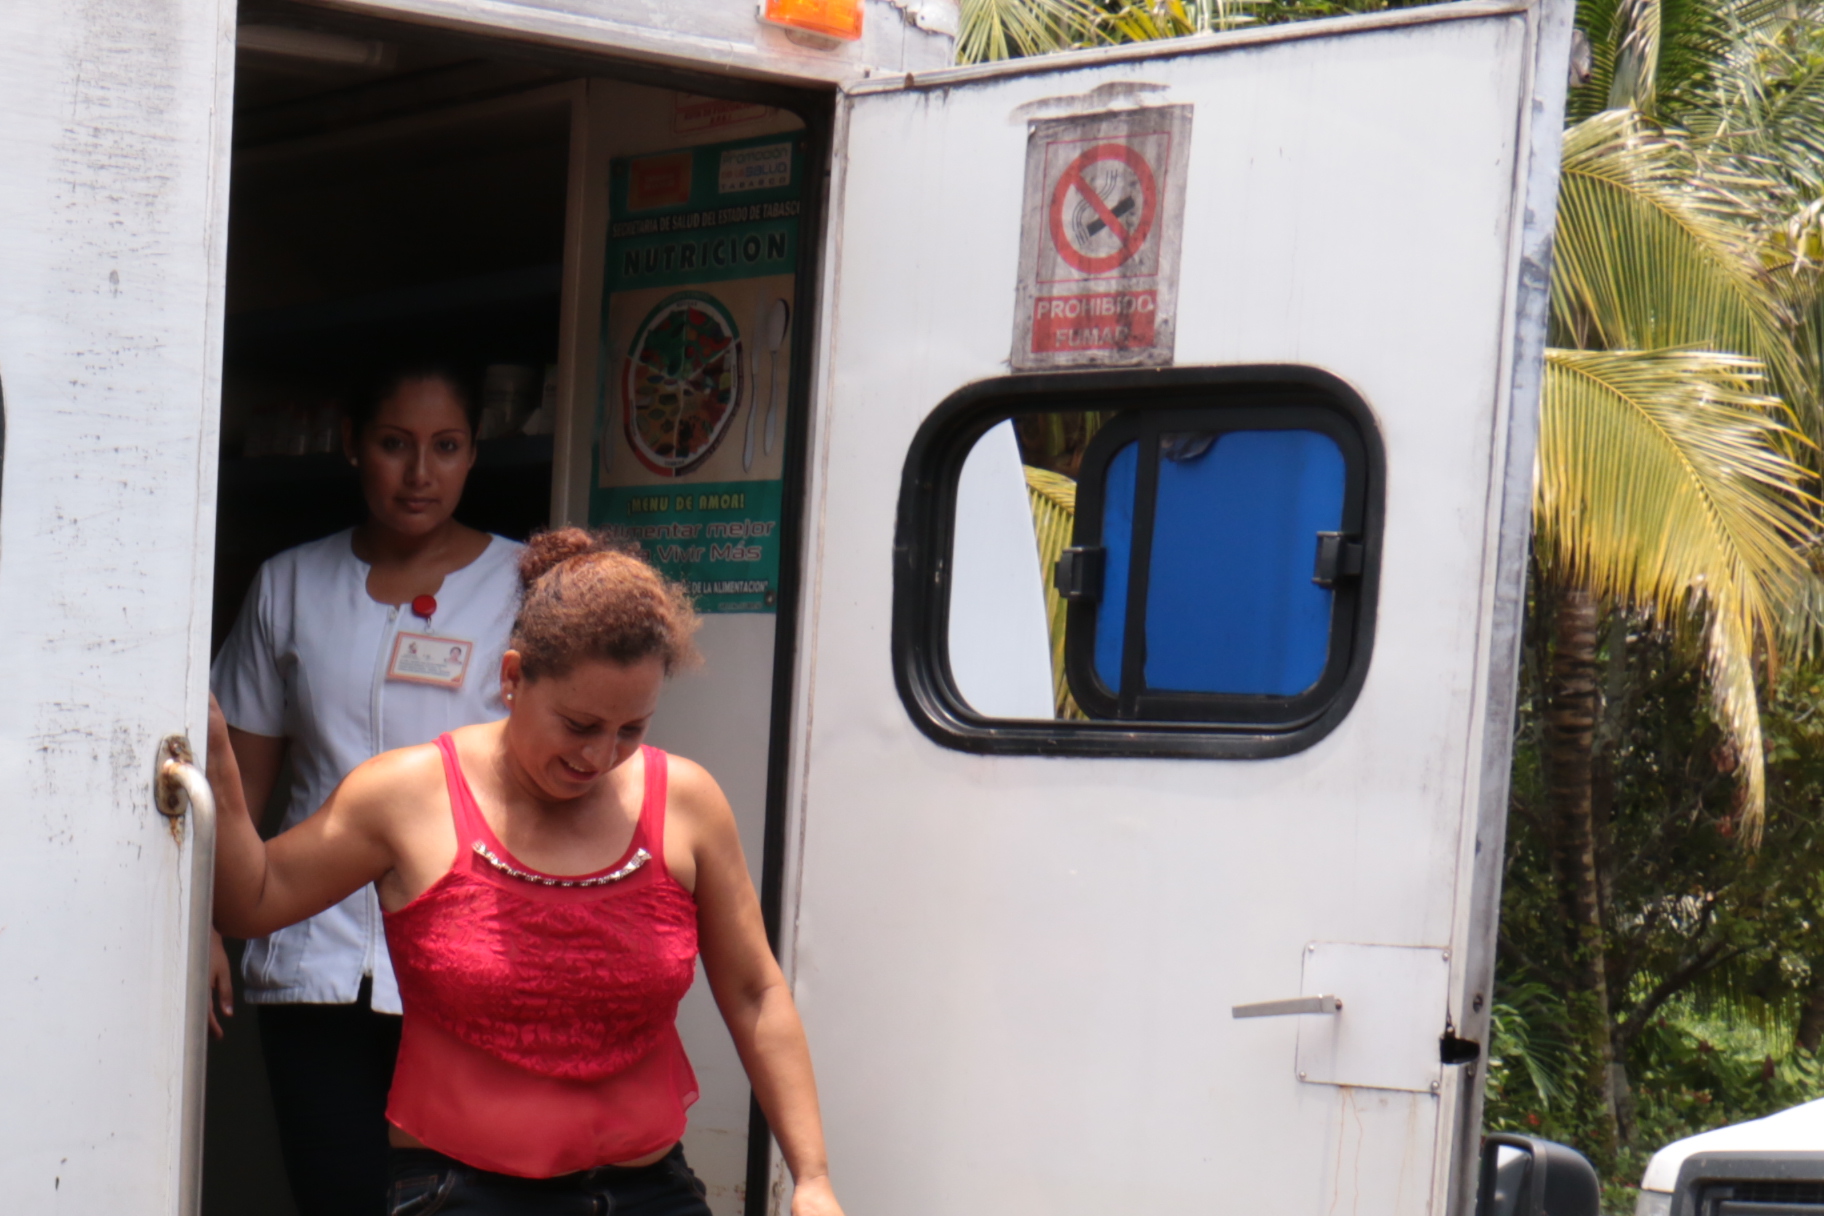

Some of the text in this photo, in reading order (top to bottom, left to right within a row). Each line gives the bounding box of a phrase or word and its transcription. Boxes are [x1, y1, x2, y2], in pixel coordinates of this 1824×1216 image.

[660, 216, 671, 232] DE
[673, 212, 700, 230] SALUD
[702, 211, 716, 227] DEL
[718, 206, 747, 225] ESTADO
[749, 204, 761, 221] DE
[623, 232, 786, 276] NUTRICION
[1038, 295, 1153, 319] PROHIBIDO
[1055, 326, 1130, 348] FUMAR
[675, 494, 693, 511] DE
[707, 518, 776, 538] mejor
[656, 543, 706, 563] Vivir
[710, 538, 763, 563] Más
[703, 580, 713, 595] LA
